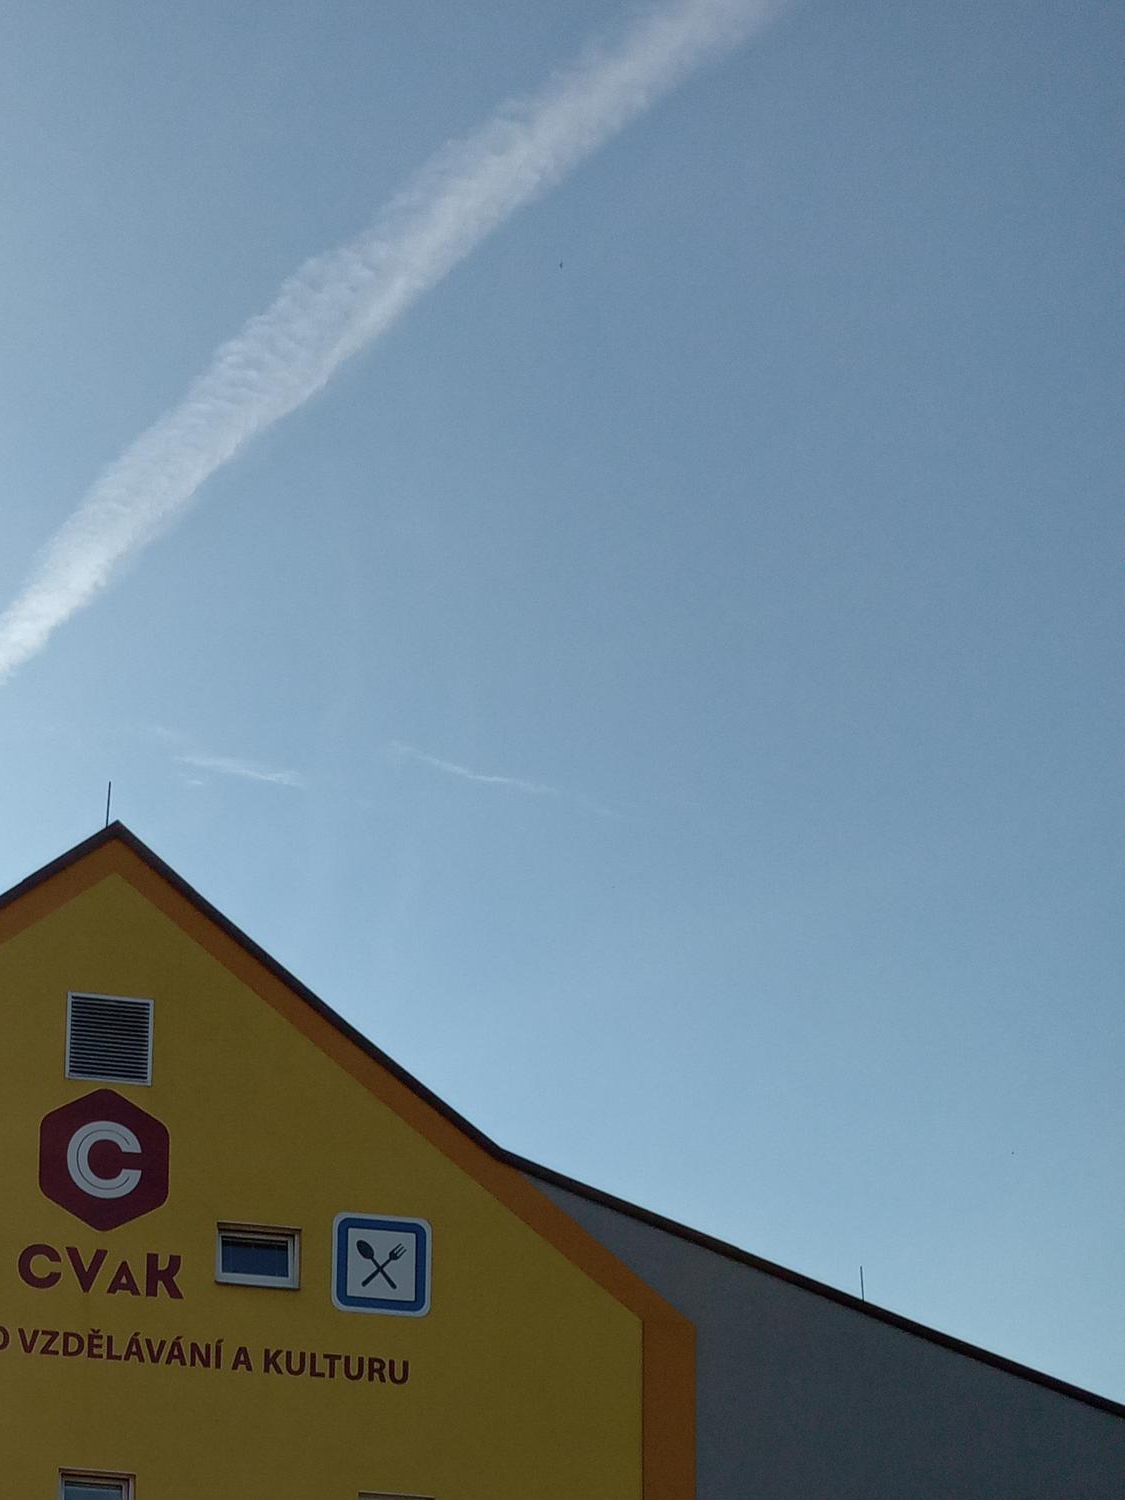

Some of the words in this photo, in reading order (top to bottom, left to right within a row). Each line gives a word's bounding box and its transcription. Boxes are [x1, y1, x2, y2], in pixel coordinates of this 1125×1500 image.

[67, 1120, 142, 1199] C
[17, 1243, 184, 1300] CVAK
[17, 1327, 224, 1369] VZDĚLÁVÁNÍ
[231, 1346, 253, 1372] A
[262, 1348, 410, 1385] KULTURU
